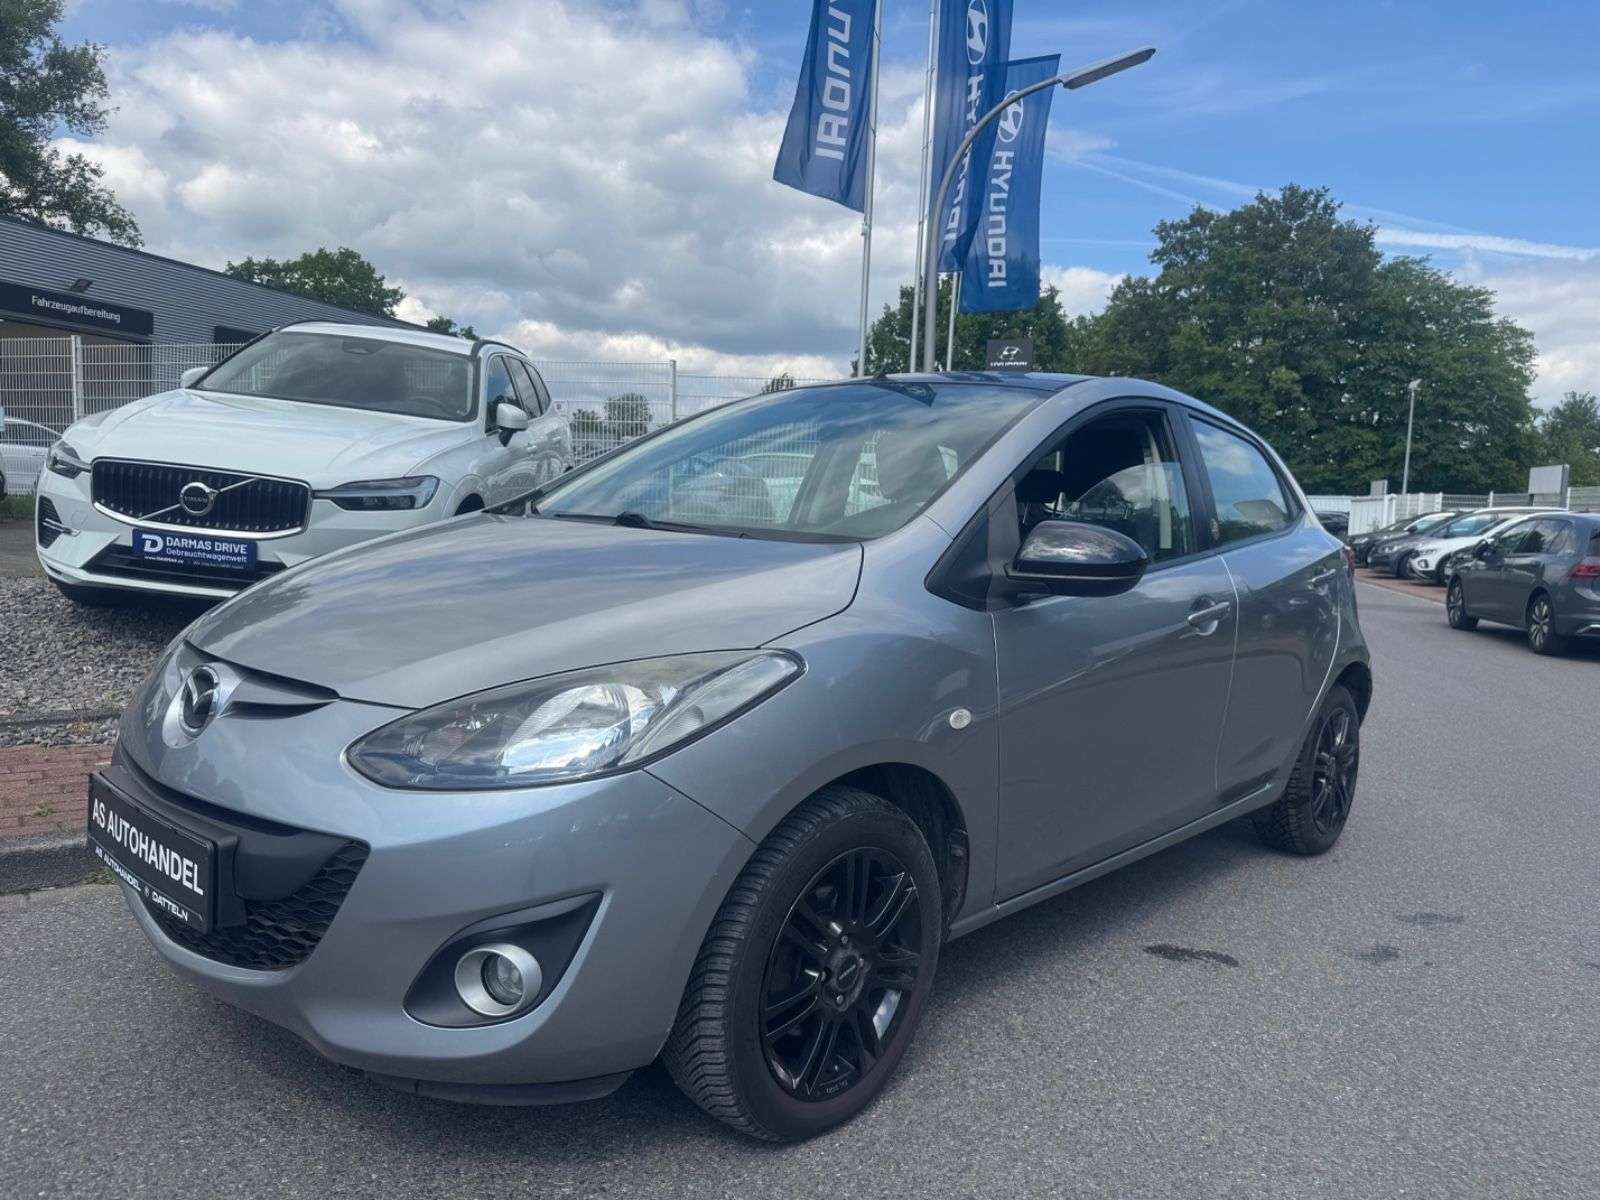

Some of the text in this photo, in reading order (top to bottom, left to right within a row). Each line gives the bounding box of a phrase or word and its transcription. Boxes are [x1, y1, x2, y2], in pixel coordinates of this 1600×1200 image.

[815, 0, 852, 161] UNDAI
[944, 74, 984, 241] HYAI
[988, 151, 1014, 287] HYUNDAI
[31, 295, 121, 323] Fahrzeugaufbereitung
[166, 536, 248, 555] DARMAS DRIVE
[166, 547, 248, 563] Gebrauchtwagenwelt
[92, 798, 204, 896] AS AUTOHANDEL
[152, 891, 188, 922] DATTELN
